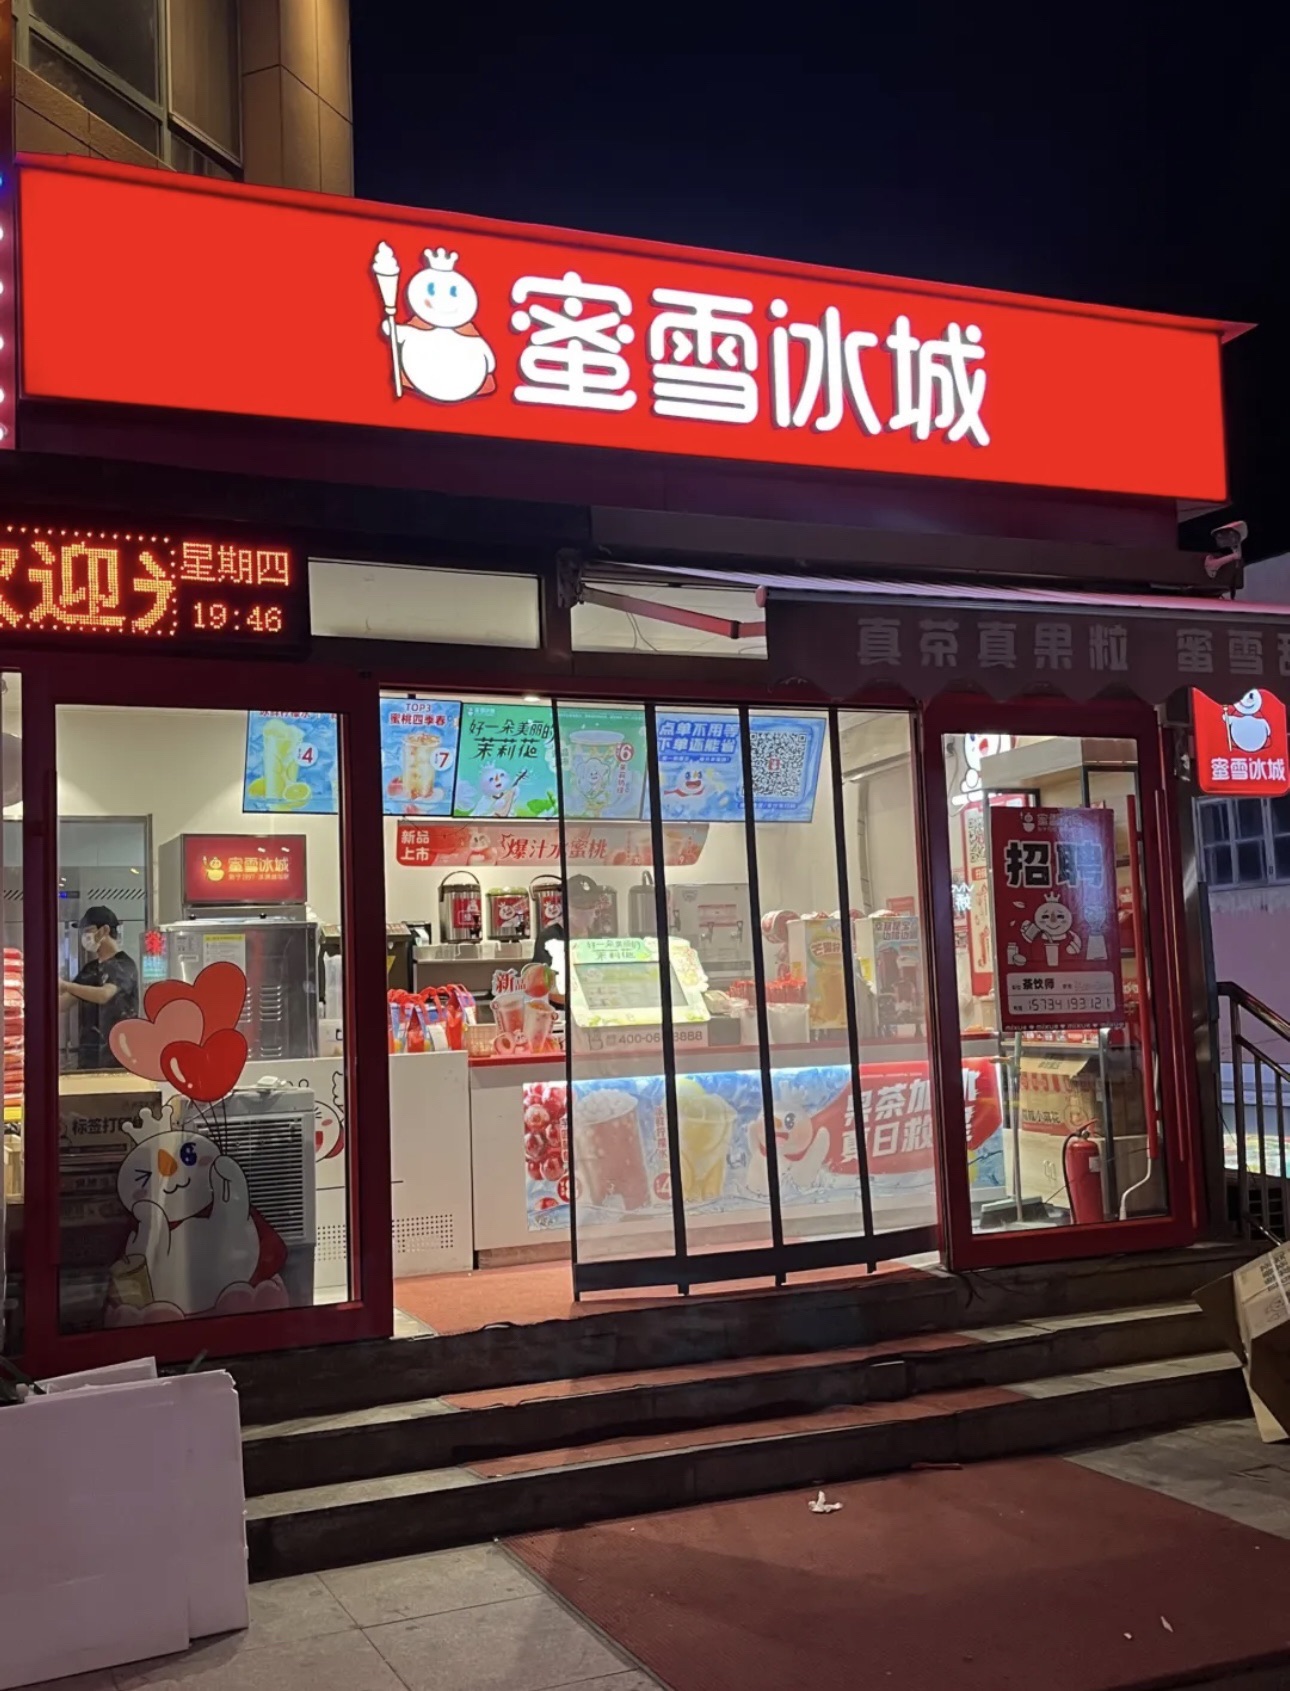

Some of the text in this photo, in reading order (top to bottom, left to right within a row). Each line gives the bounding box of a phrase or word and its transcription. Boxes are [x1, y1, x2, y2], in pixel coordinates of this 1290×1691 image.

[510, 271, 990, 446] 蜜雪冰城
[181, 541, 289, 586] 星期四
[194, 602, 282, 632] 19:46
[857, 617, 1128, 671] 真茶真果粒
[405, 703, 431, 713] TOP3
[389, 713, 446, 726] 蜜桃四季春
[469, 718, 555, 742] 好一朵美丽的
[658, 720, 740, 737] 点单不用等
[470, 737, 540, 760] 茉莉花
[620, 744, 632, 761] 6
[657, 737, 736, 753] 下单还能省
[302, 747, 313, 763] 4
[438, 752, 450, 768] 7
[1211, 757, 1286, 781] 蜜雪冰城
[401, 830, 430, 844] 新品
[400, 847, 430, 861] 上市
[504, 837, 608, 861] 爆汁水蜜桃
[228, 856, 289, 873] 蜜雪冰城
[1004, 840, 1103, 888] 招聘
[496, 973, 528, 993] 新品
[1022, 978, 1055, 990] 茶饮师
